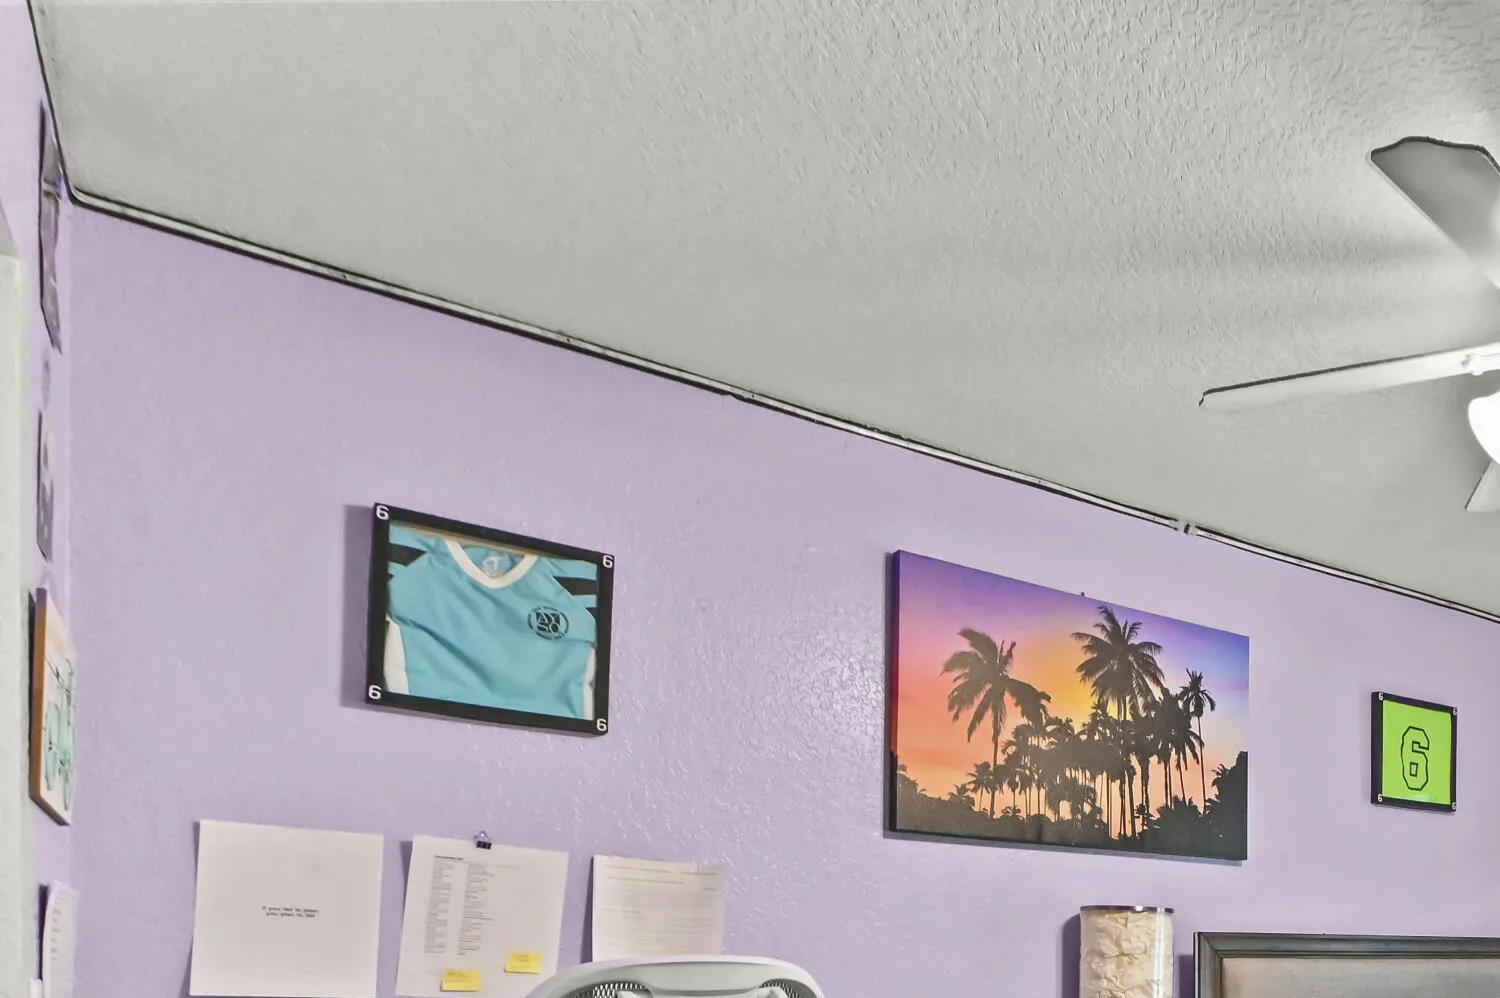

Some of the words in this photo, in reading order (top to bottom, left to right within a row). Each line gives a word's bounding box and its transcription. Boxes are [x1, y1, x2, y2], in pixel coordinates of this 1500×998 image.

[376, 504, 390, 520] 6
[602, 554, 614, 569] 6
[368, 684, 382, 700] 6
[596, 717, 608, 732] 6
[1400, 725, 1430, 791] 6
